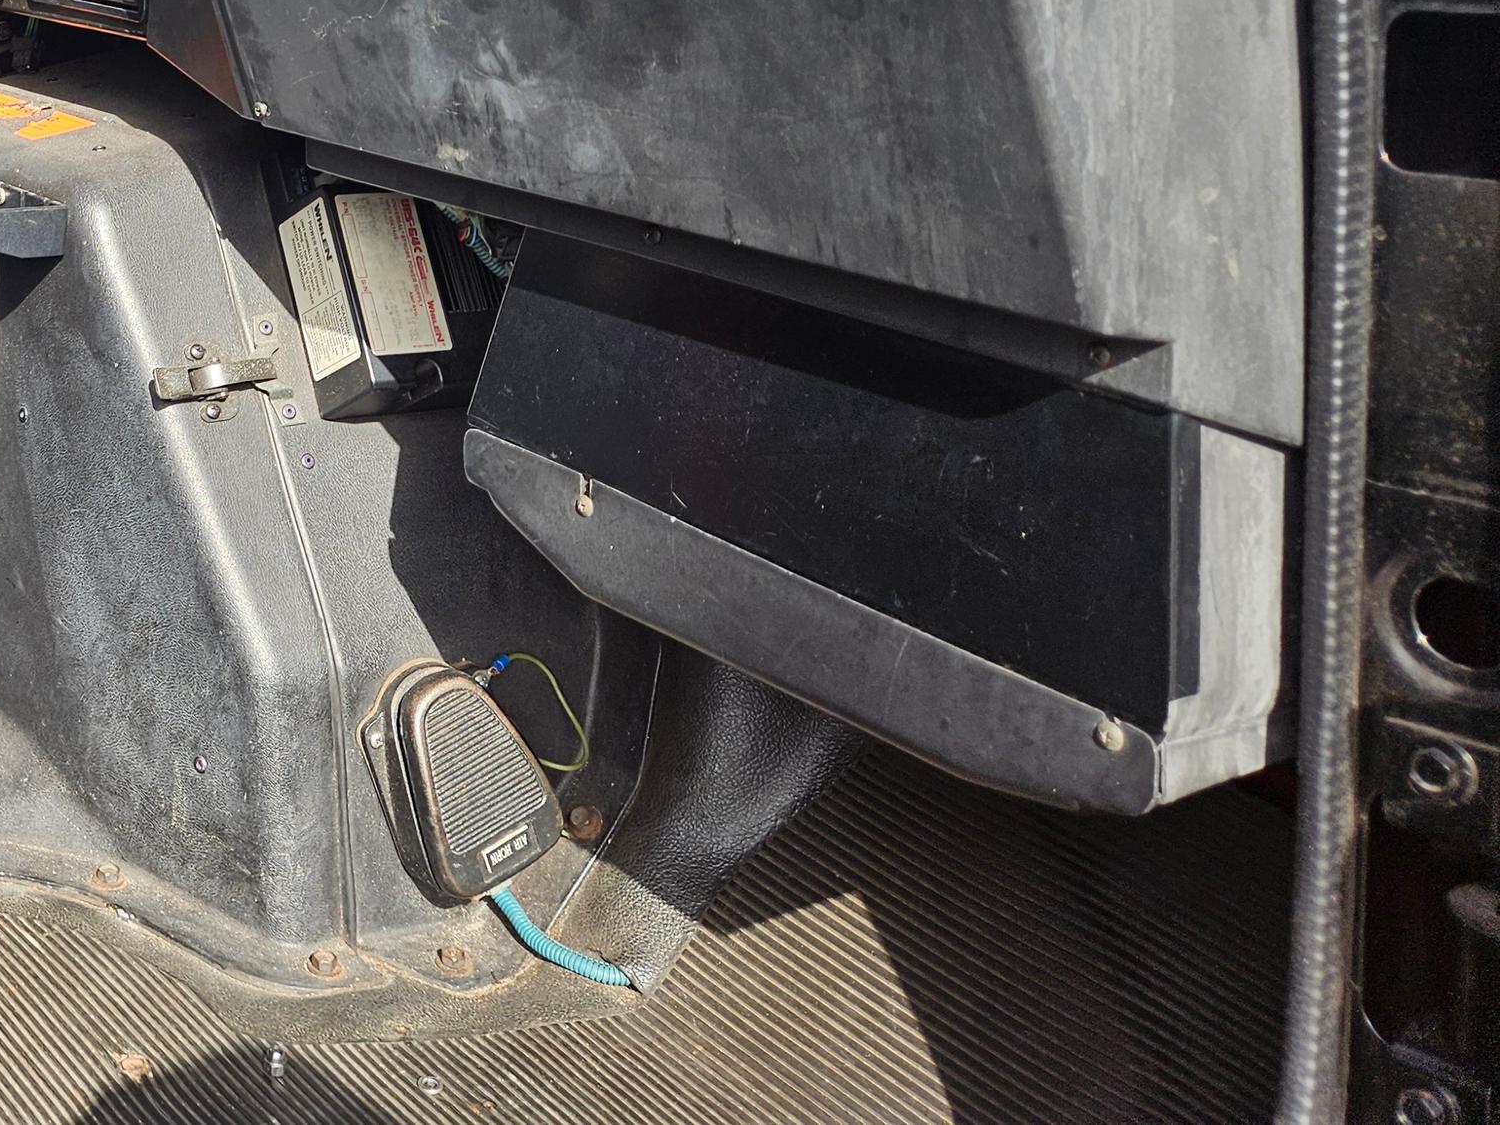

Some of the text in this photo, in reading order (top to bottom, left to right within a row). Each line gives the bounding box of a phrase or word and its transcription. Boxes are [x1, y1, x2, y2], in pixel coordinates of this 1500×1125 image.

[307, 220, 326, 286] POWER SWITCHING
[314, 203, 332, 261] WHELEN
[339, 317, 349, 350] VOLTAGE
[427, 300, 444, 342] WHELEN
[490, 833, 528, 866] AIR HORN
